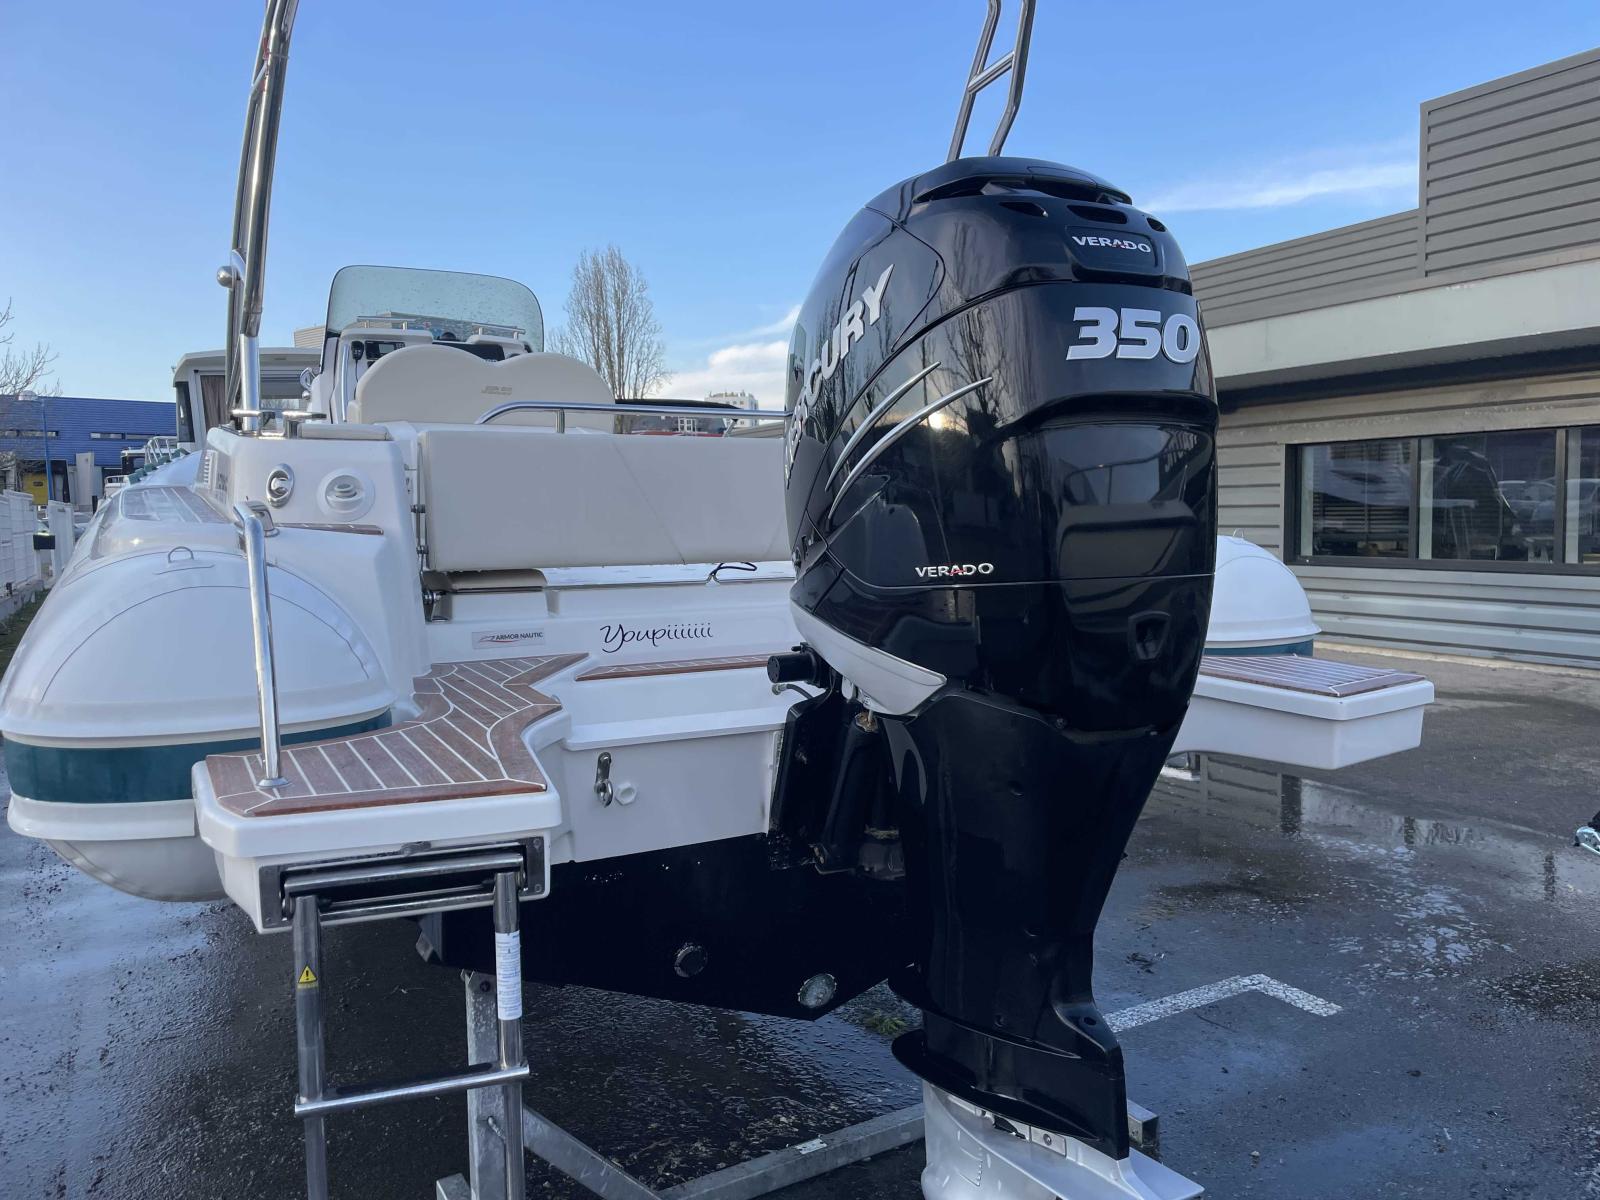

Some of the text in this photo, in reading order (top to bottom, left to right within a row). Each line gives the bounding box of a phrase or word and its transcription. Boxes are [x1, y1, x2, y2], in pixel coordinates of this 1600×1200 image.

[1071, 236, 1151, 253] VERADO
[1065, 306, 1200, 364] 350
[914, 562, 994, 578] VERADO
[495, 631, 544, 641] ARMOR NAUTIC
